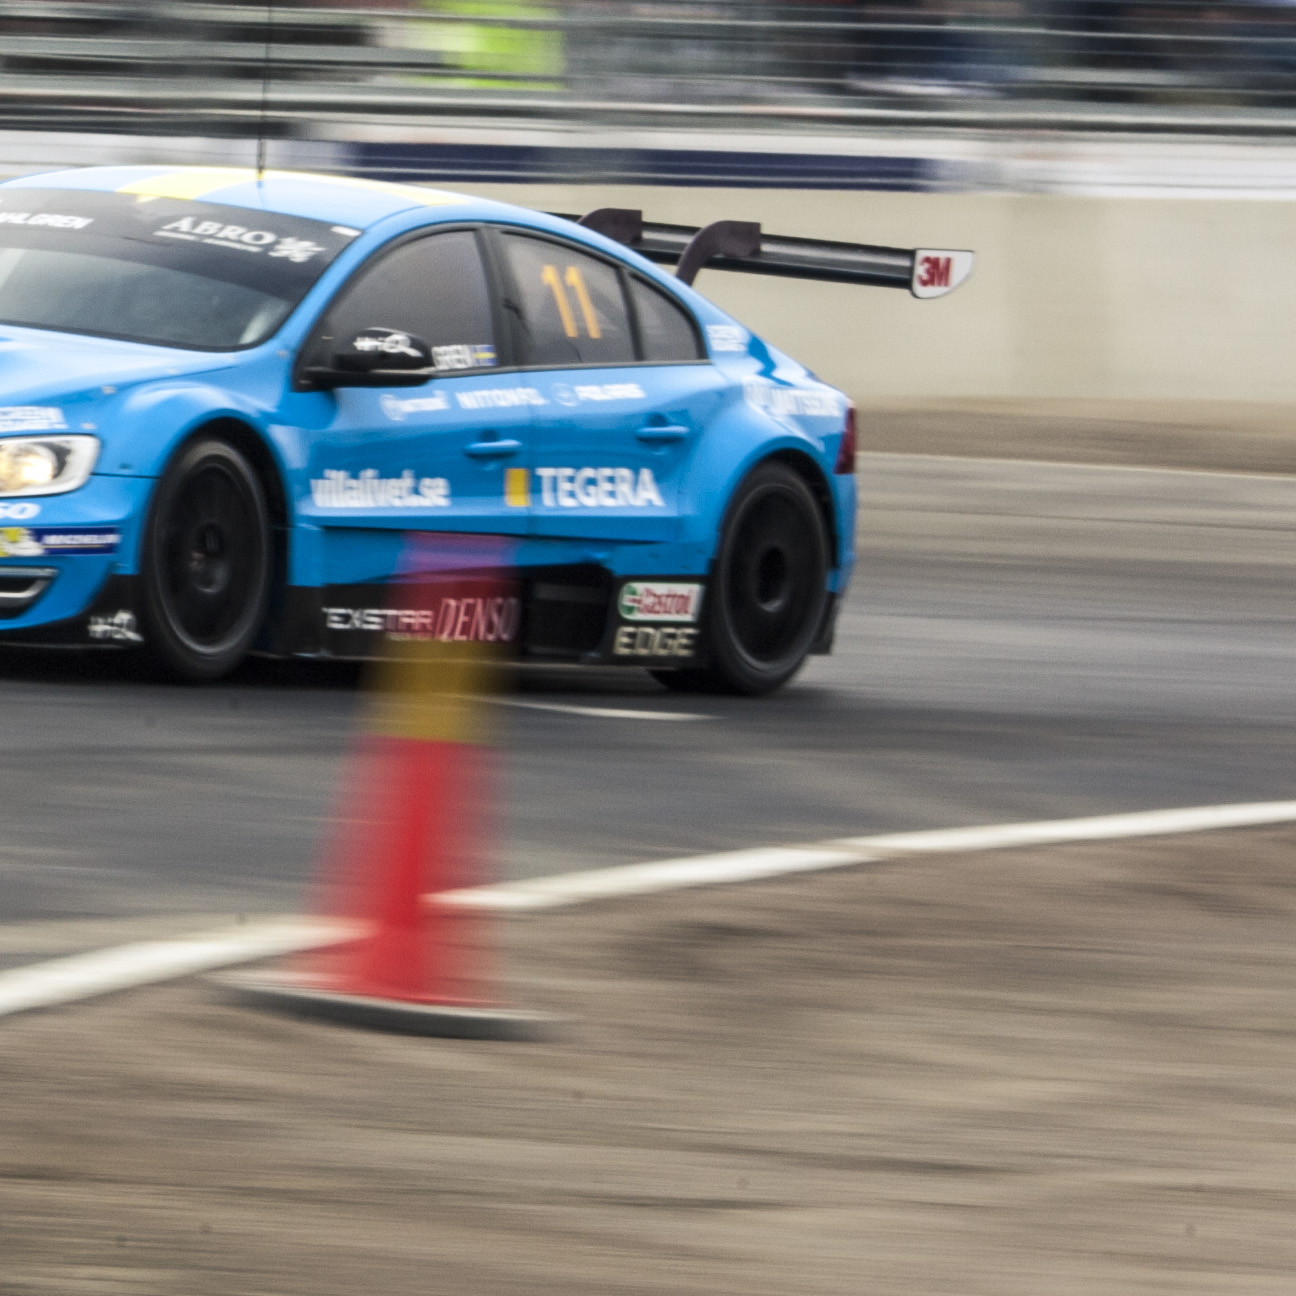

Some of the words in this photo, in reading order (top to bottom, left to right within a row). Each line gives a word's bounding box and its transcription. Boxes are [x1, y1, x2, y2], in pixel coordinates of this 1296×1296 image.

[918, 256, 952, 288] 3M
[541, 264, 602, 339] 11
[535, 466, 666, 508] TEGERA
[612, 626, 700, 657] EDGE
